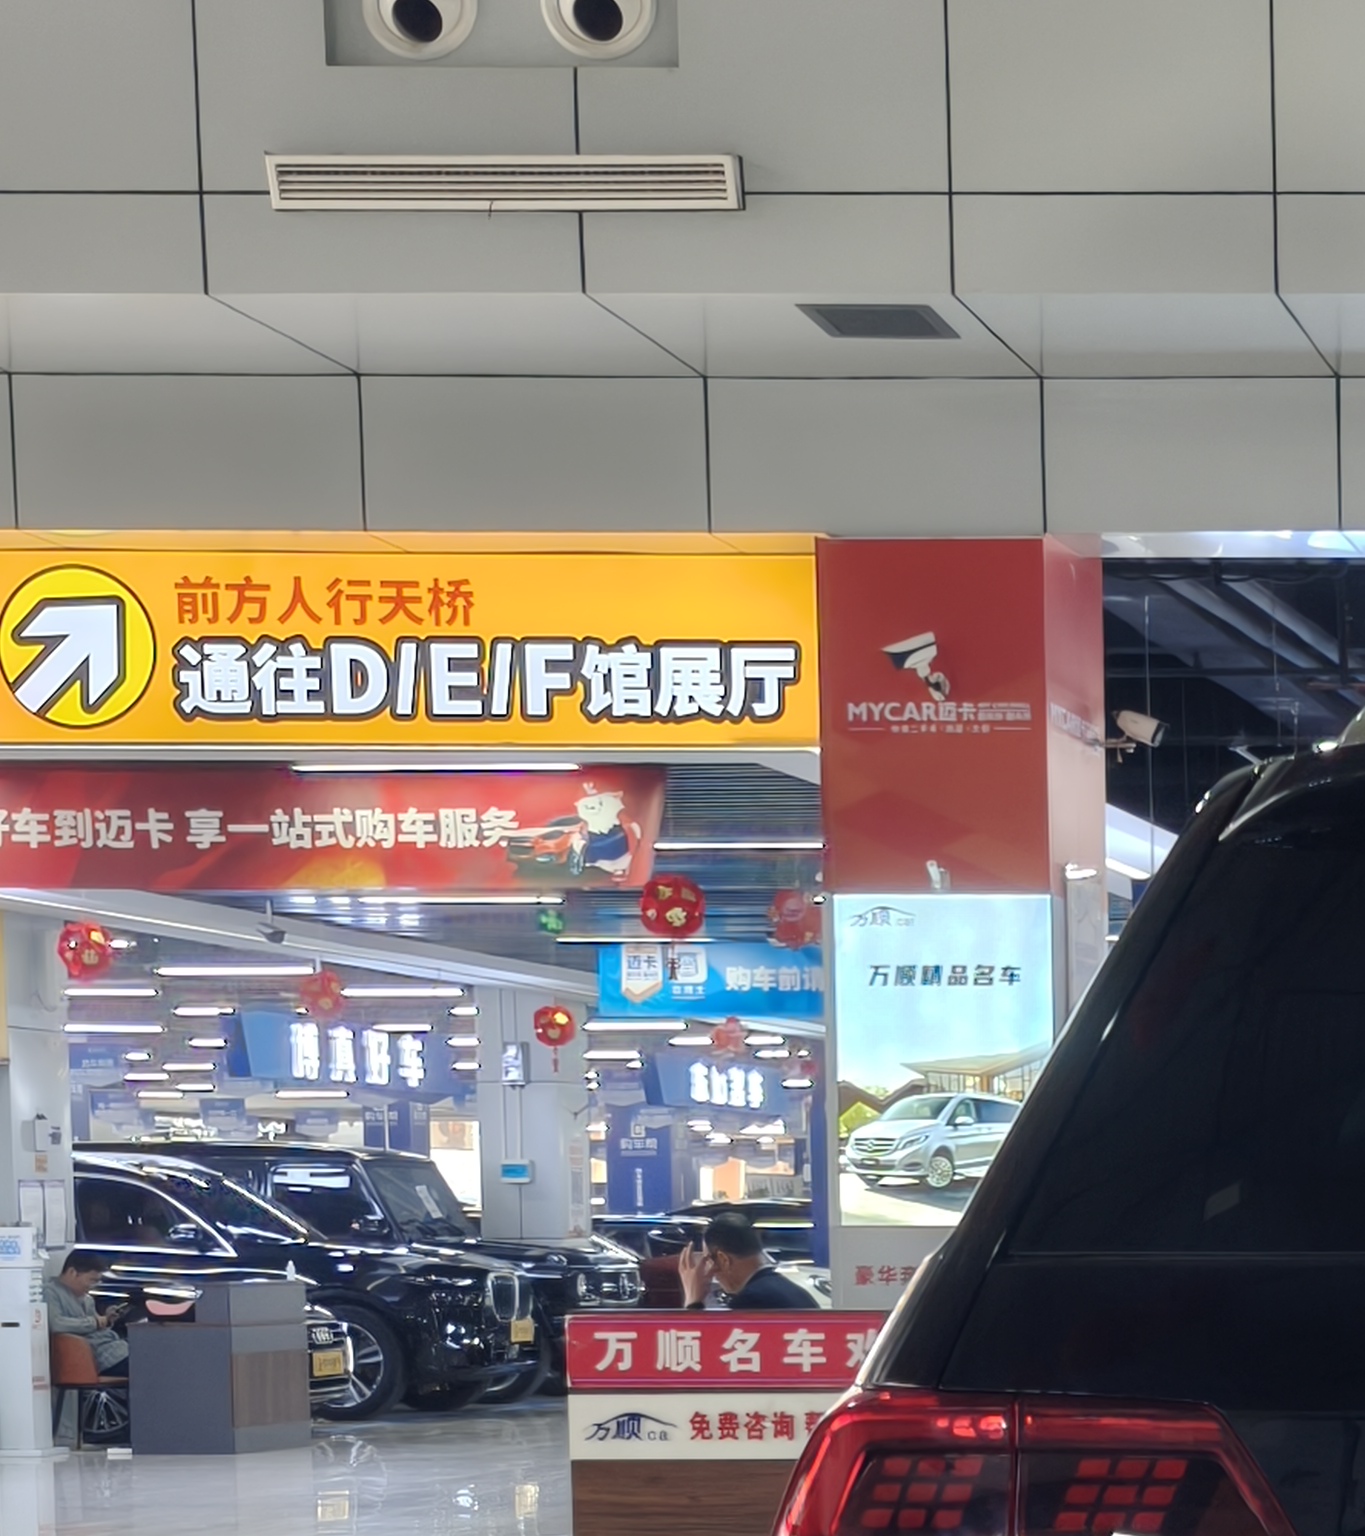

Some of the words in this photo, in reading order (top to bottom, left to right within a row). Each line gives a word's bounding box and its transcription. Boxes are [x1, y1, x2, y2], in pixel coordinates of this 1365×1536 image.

[174, 576, 476, 627] 前方人行天桥
[177, 641, 798, 720] 通往D/E/F馆展厅
[186, 807, 520, 852] 享一站式购车服务
[868, 964, 1022, 987] 万顺精品名车
[689, 1411, 795, 1441] 免费咨询
